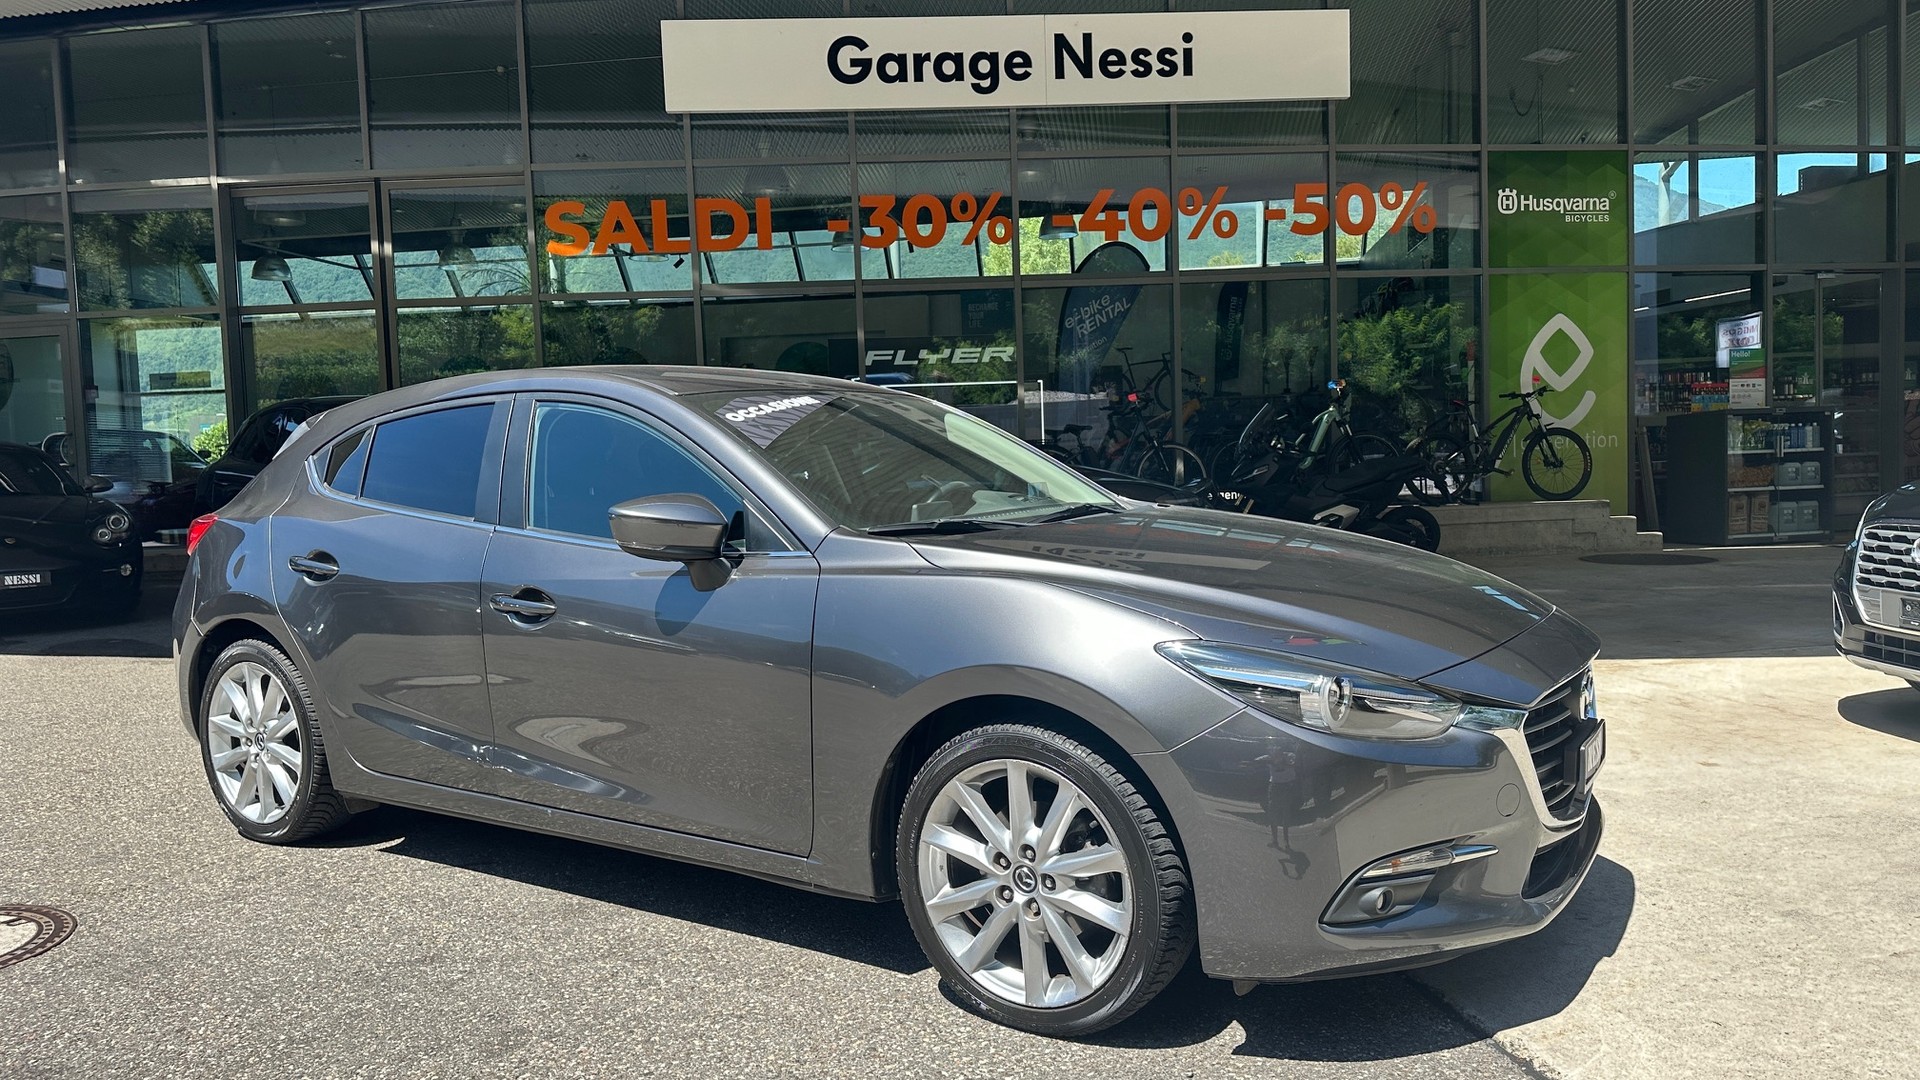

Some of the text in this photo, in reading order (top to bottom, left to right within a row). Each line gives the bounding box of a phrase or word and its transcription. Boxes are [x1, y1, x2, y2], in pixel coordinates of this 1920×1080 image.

[827, 32, 1194, 95] Garage Nessi
[1520, 195, 1610, 214] Husqvarna
[545, 181, 1438, 257] SALDI -30% -40% -50%
[1565, 214, 1610, 223] BICYCLES
[1064, 294, 1111, 329] e-bike
[1076, 297, 1132, 338] RENTAL
[865, 346, 1015, 367] FLYER
[1731, 350, 1751, 358] Hello!
[725, 395, 821, 422] OCCASIONE
[4, 573, 41, 586] NESSI
